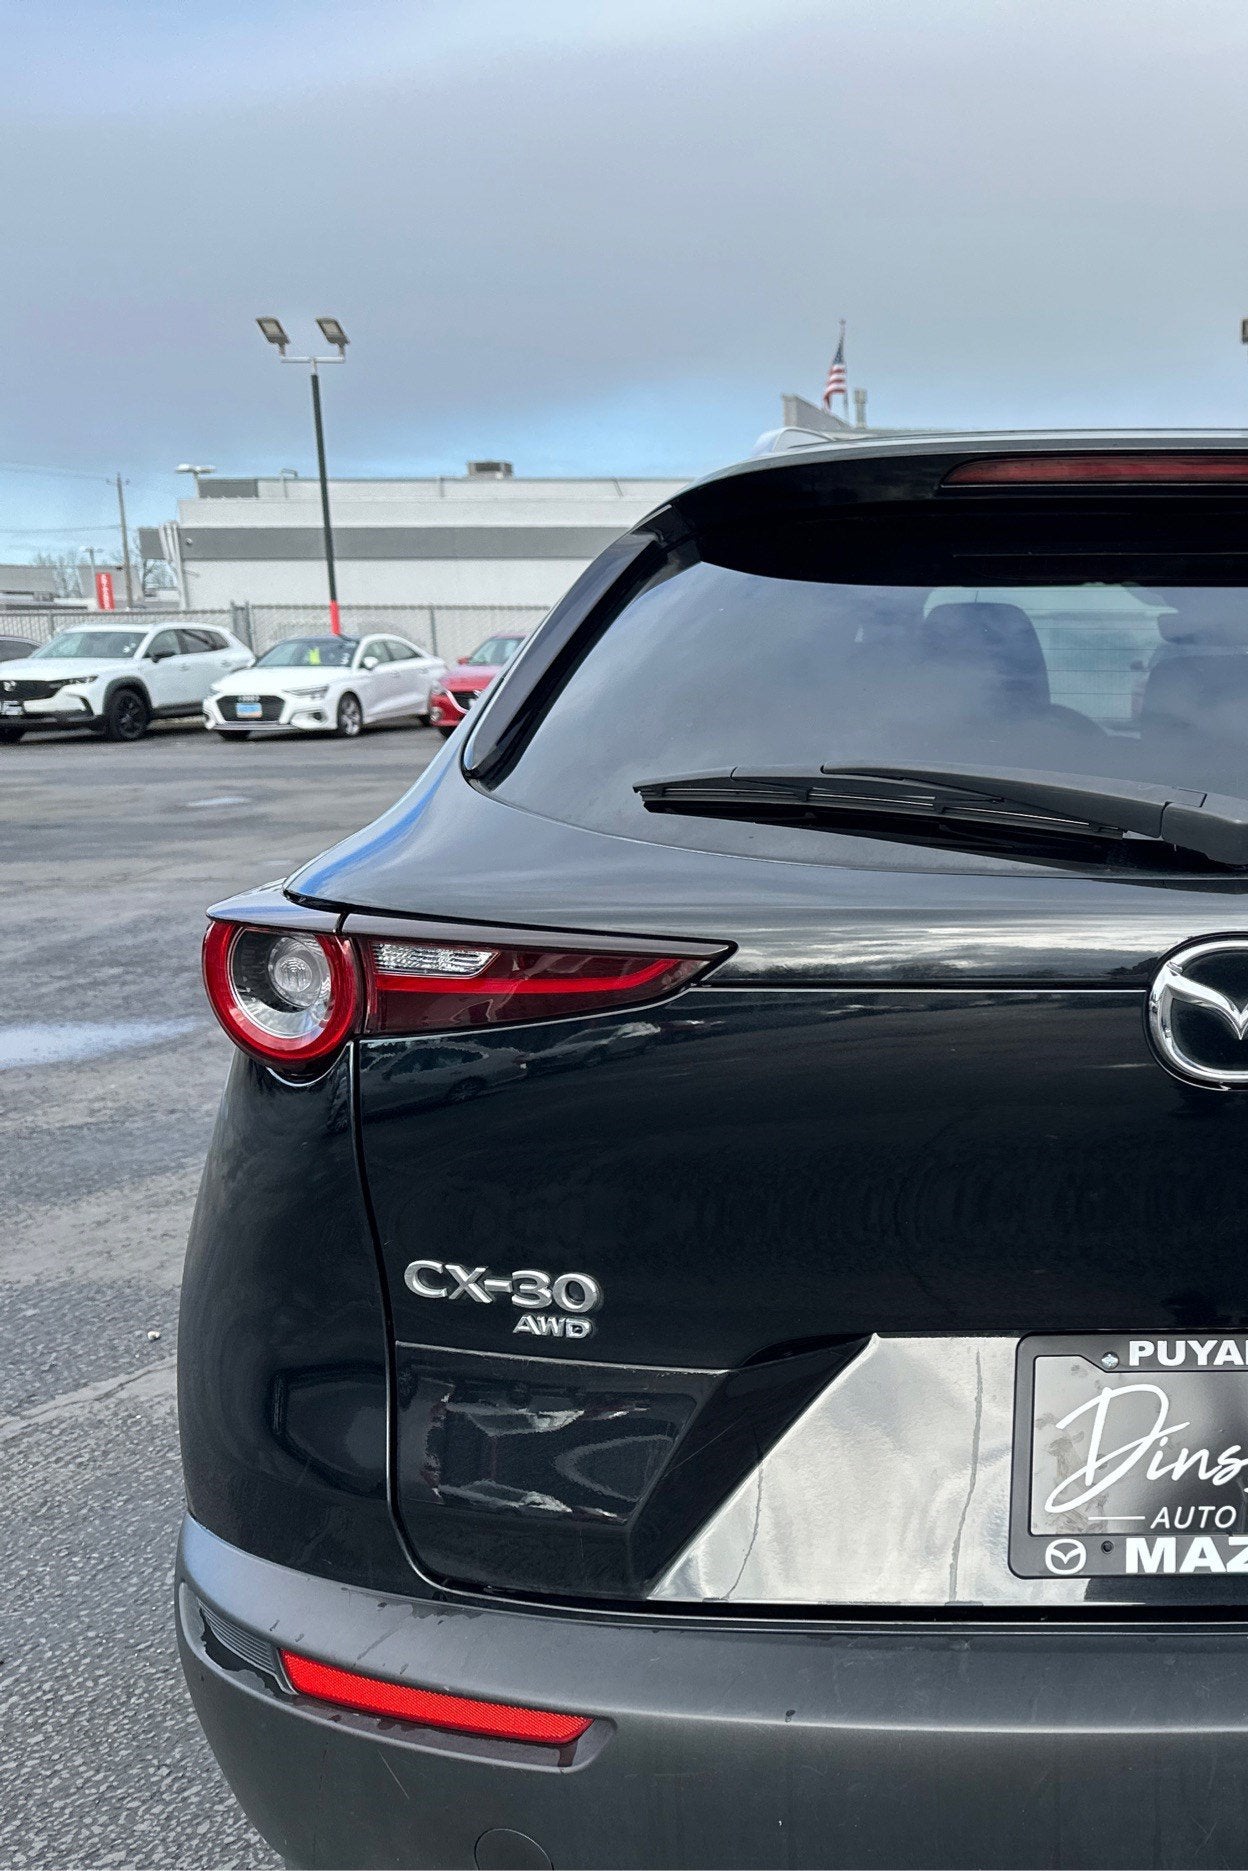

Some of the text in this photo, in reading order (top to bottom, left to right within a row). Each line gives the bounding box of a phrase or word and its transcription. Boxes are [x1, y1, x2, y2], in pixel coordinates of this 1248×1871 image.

[404, 1260, 601, 1313] CX-30
[513, 1314, 592, 1339] AWD
[1150, 1505, 1237, 1529] AUTO
